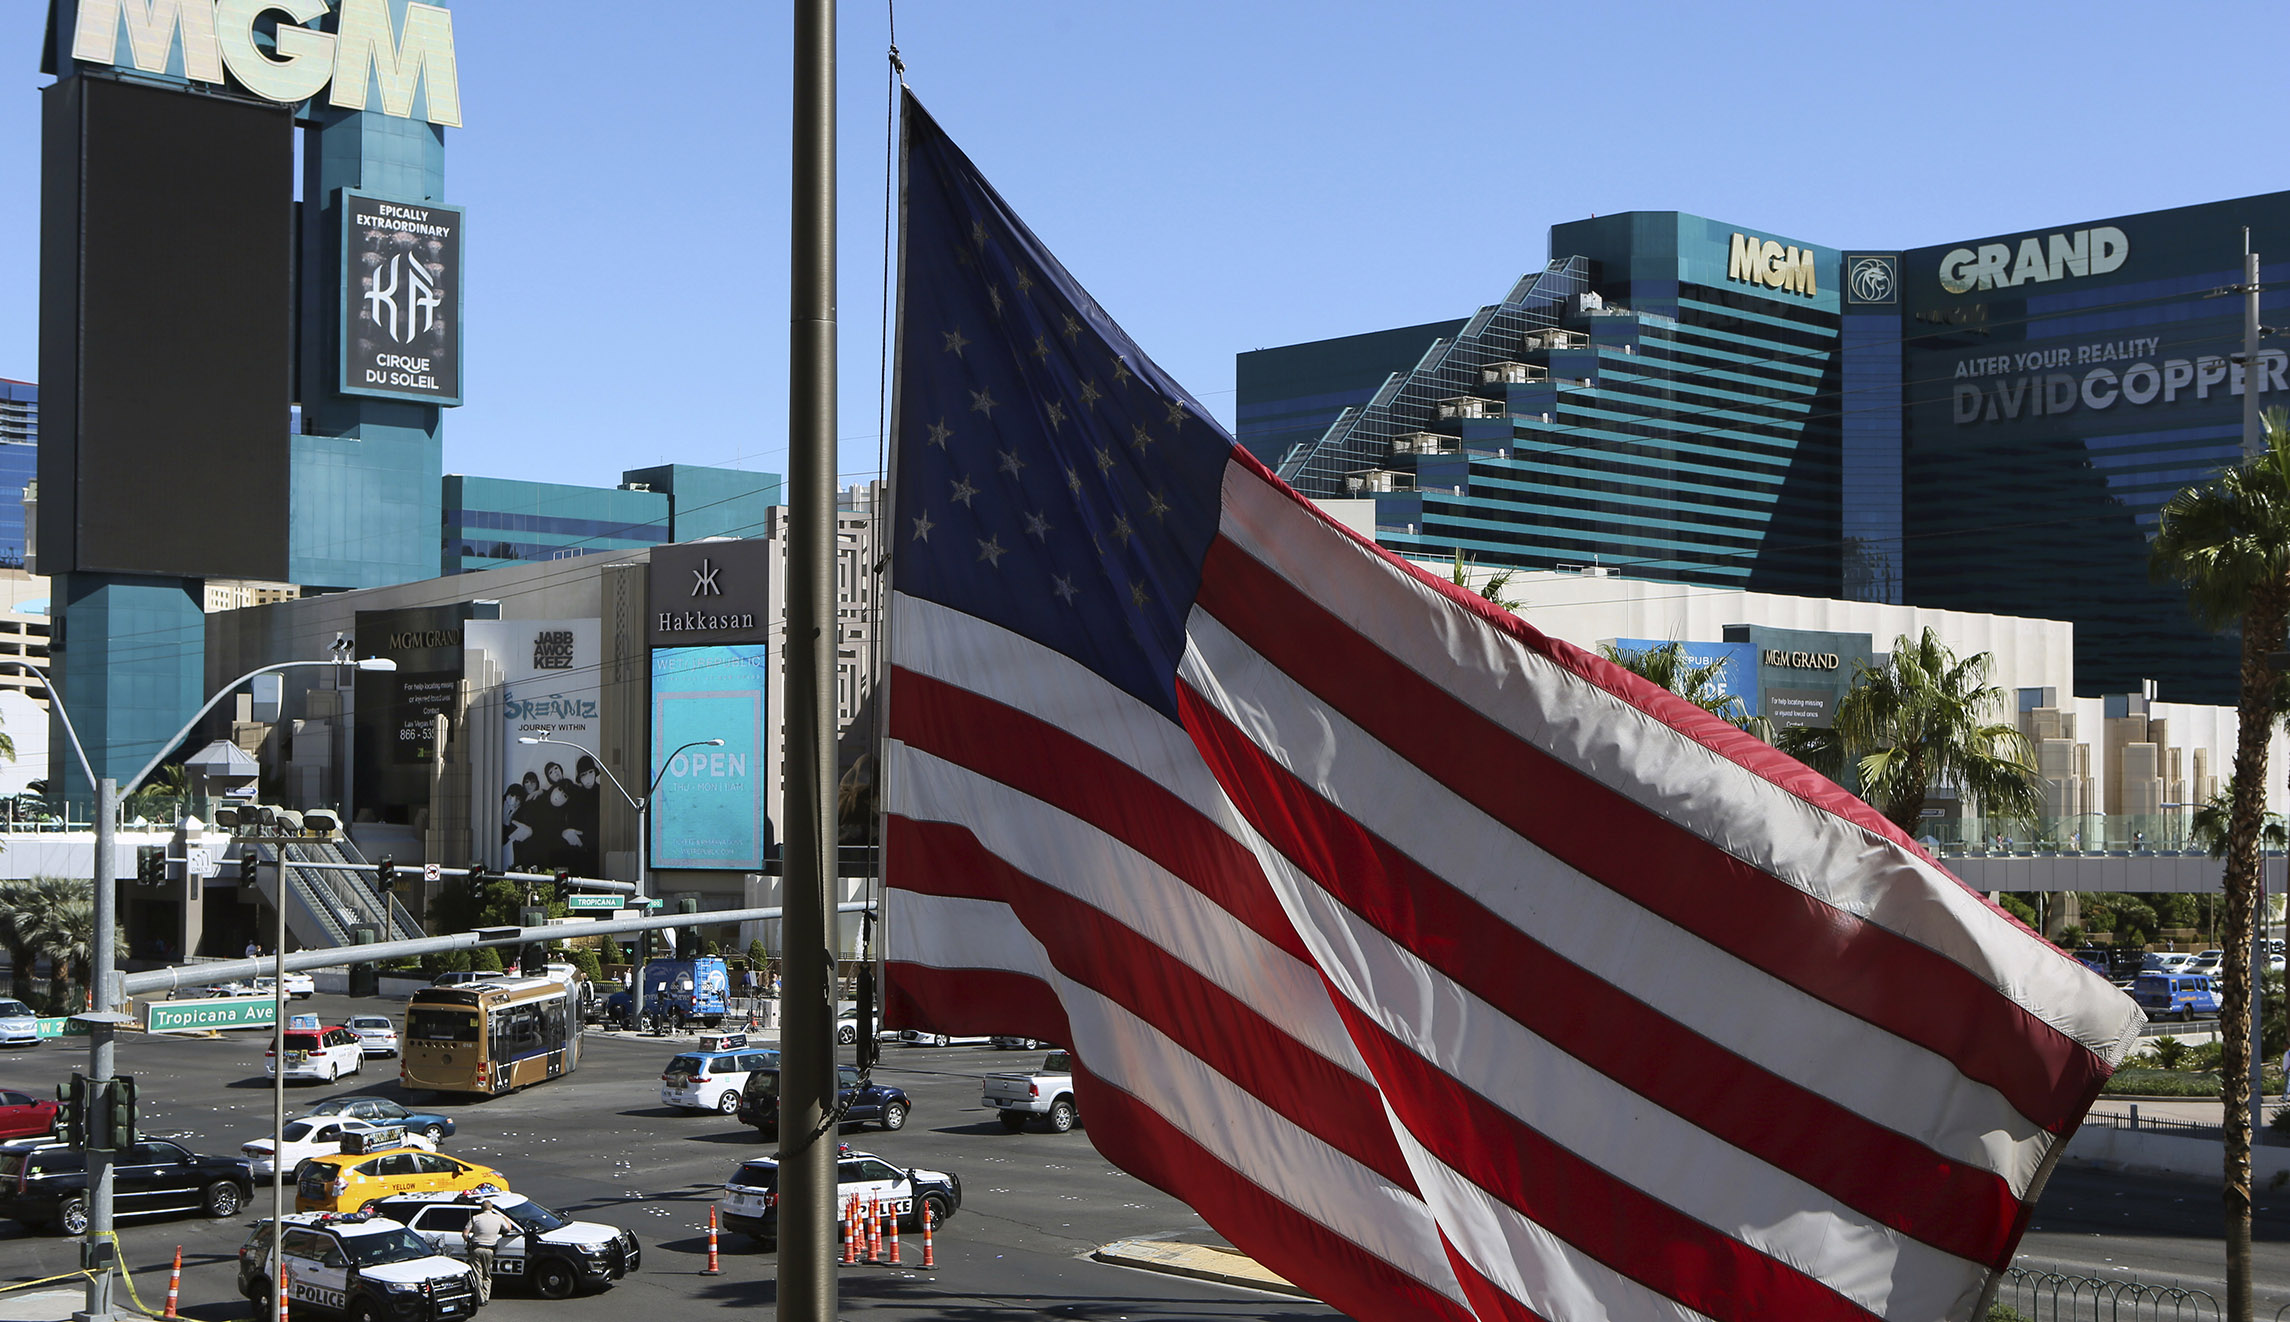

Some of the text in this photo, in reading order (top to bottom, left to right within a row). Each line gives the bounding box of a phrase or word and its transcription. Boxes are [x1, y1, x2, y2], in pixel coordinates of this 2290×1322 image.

[72, 0, 462, 128] MGM
[379, 204, 429, 222] EPICALLY
[356, 214, 450, 238] EXTRAORDINARY
[1728, 232, 1817, 296] MGM
[1938, 226, 2130, 294] GRAND
[376, 353, 430, 374] CIRQUE
[1954, 337, 2160, 379] ALTER YOUR REALITY
[366, 369, 440, 390] DU SOLEIL
[658, 611, 754, 632] Hakkasan
[389, 627, 460, 650] MGM GRAND
[534, 631, 574, 645] JABB
[533, 644, 574, 656] AWOC
[533, 656, 573, 669] KEEZ
[1764, 649, 1839, 669] MGM GRAND
[404, 683, 413, 691] For
[1804, 699, 1824, 708] missing
[404, 720, 414, 728] Las
[518, 724, 557, 732] JOURNEY
[400, 729, 416, 740] 866
[670, 753, 746, 777] OPEN
[697, 782, 718, 792] MON
[577, 898, 616, 906] TROPICANA
[157, 1006, 274, 1026] Tropicana Ave
[40, 1021, 88, 1034] W 2100
[392, 1182, 416, 1191] YELLOW
[859, 1200, 910, 1215] PLICE
[491, 1259, 523, 1274] ICE
[296, 1284, 345, 1308] POLICE
